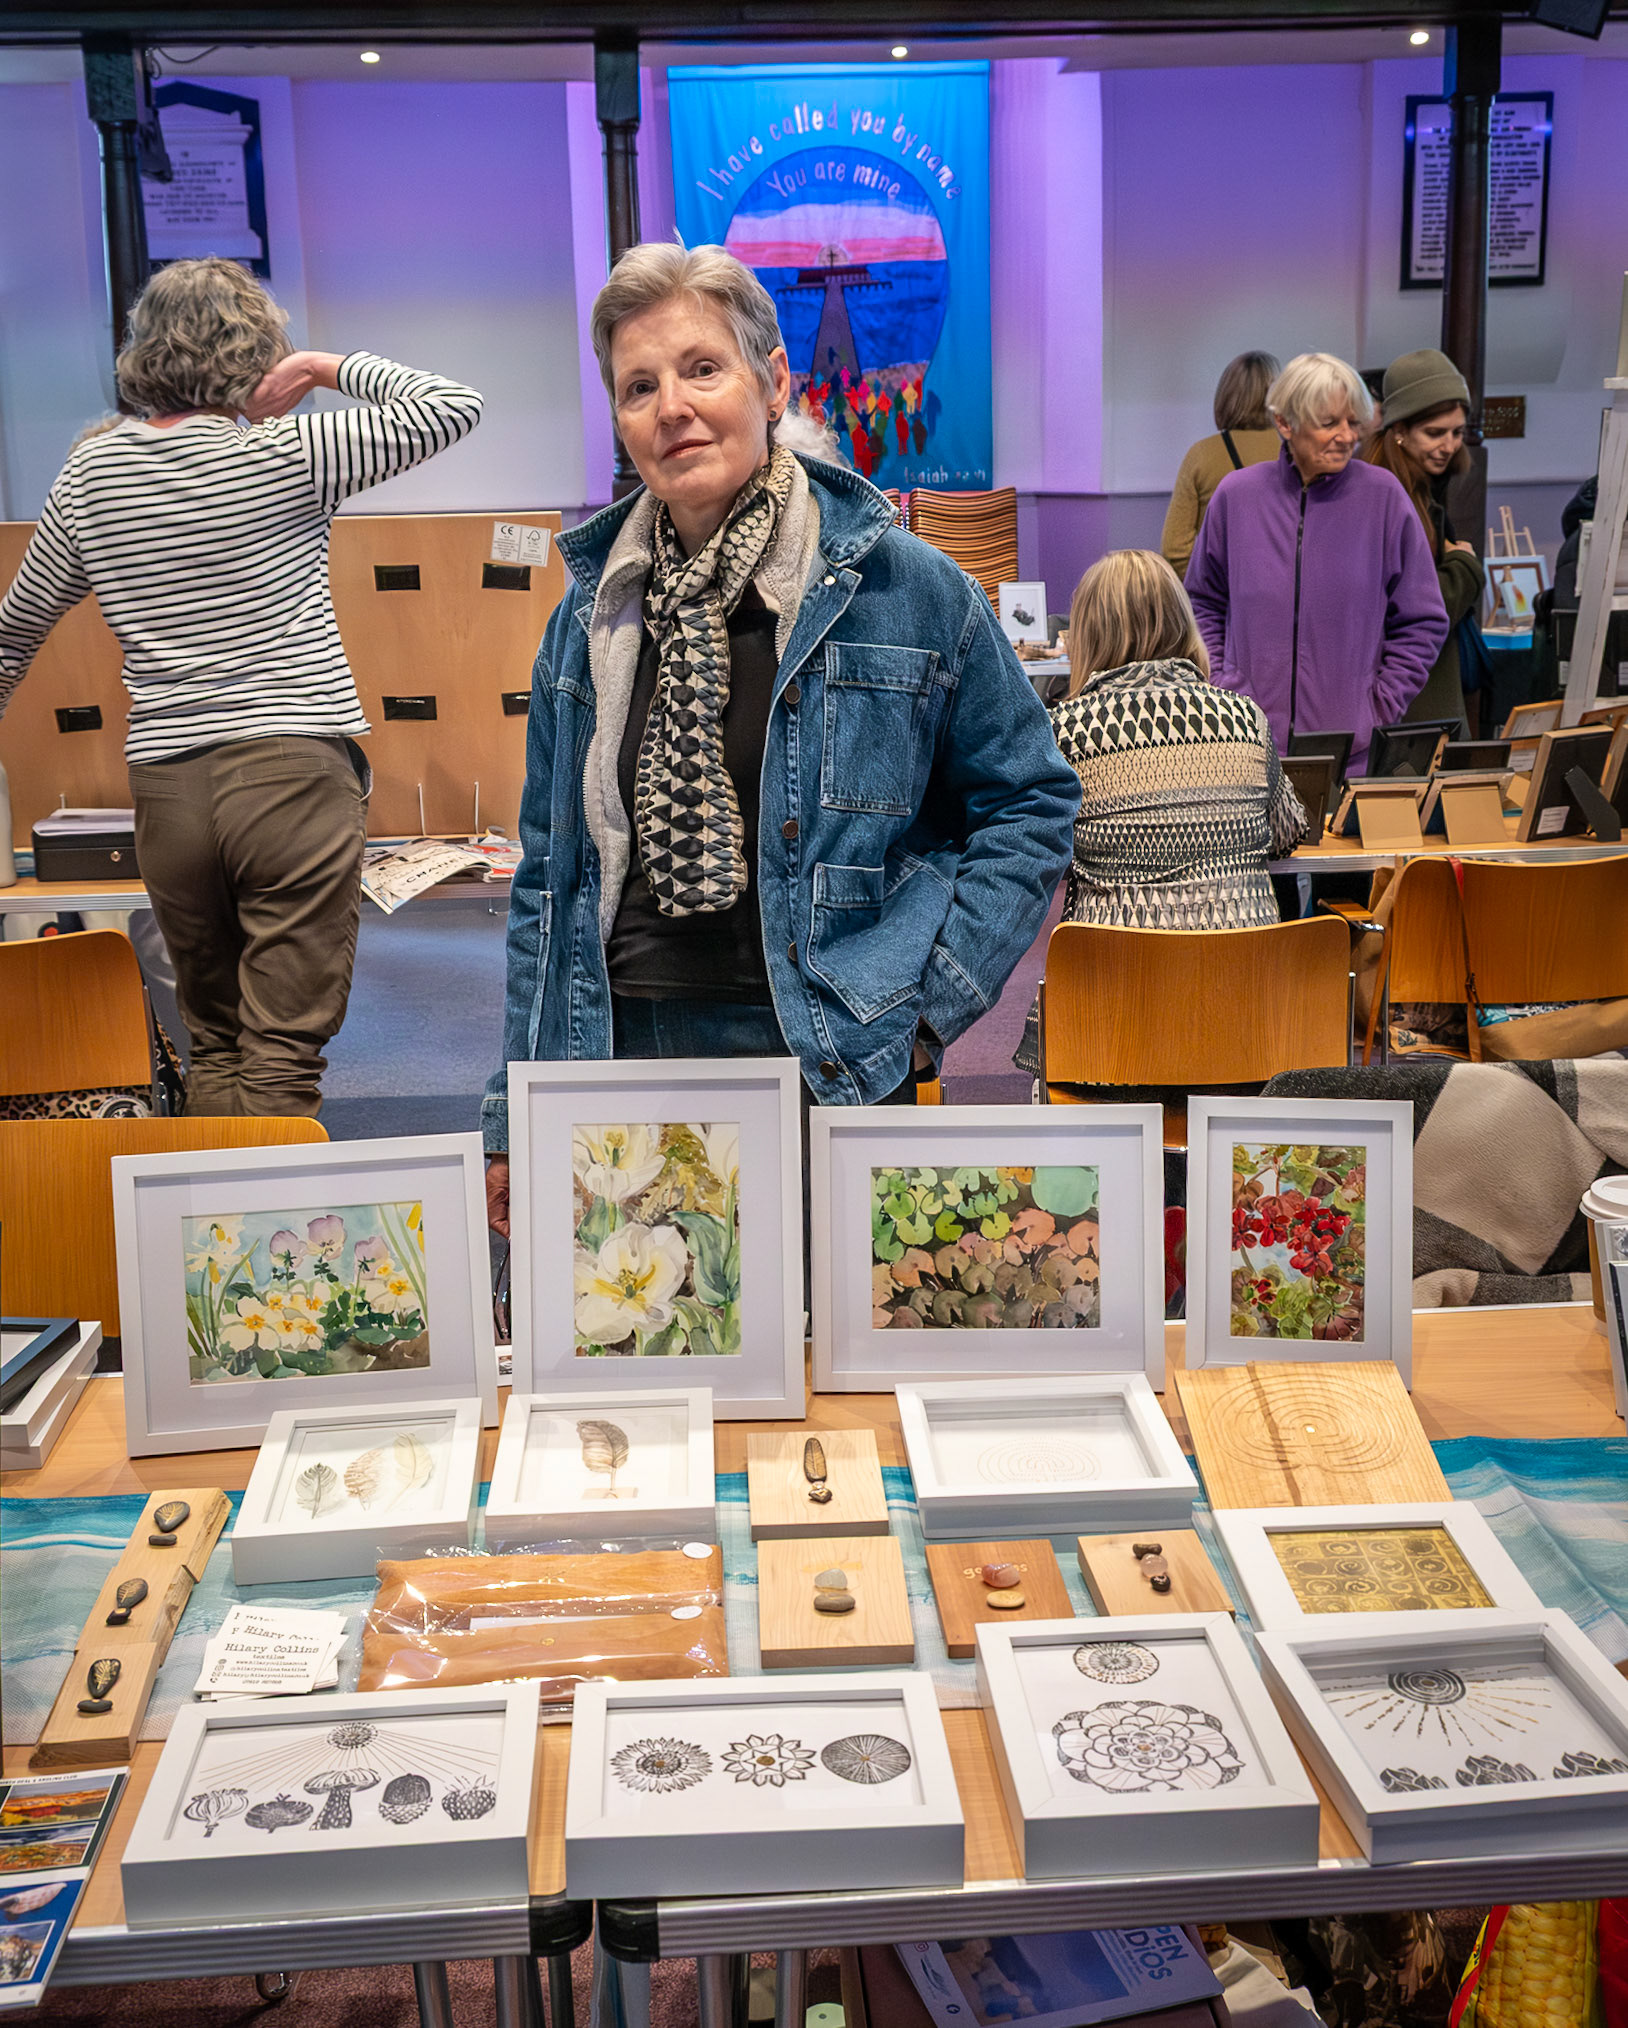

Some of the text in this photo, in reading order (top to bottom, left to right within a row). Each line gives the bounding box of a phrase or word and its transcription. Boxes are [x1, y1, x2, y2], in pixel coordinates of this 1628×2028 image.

[696, 100, 962, 201] I have called you by name
[766, 161, 901, 201] You are mine
[225, 1643, 320, 1654] Hilary Collins
